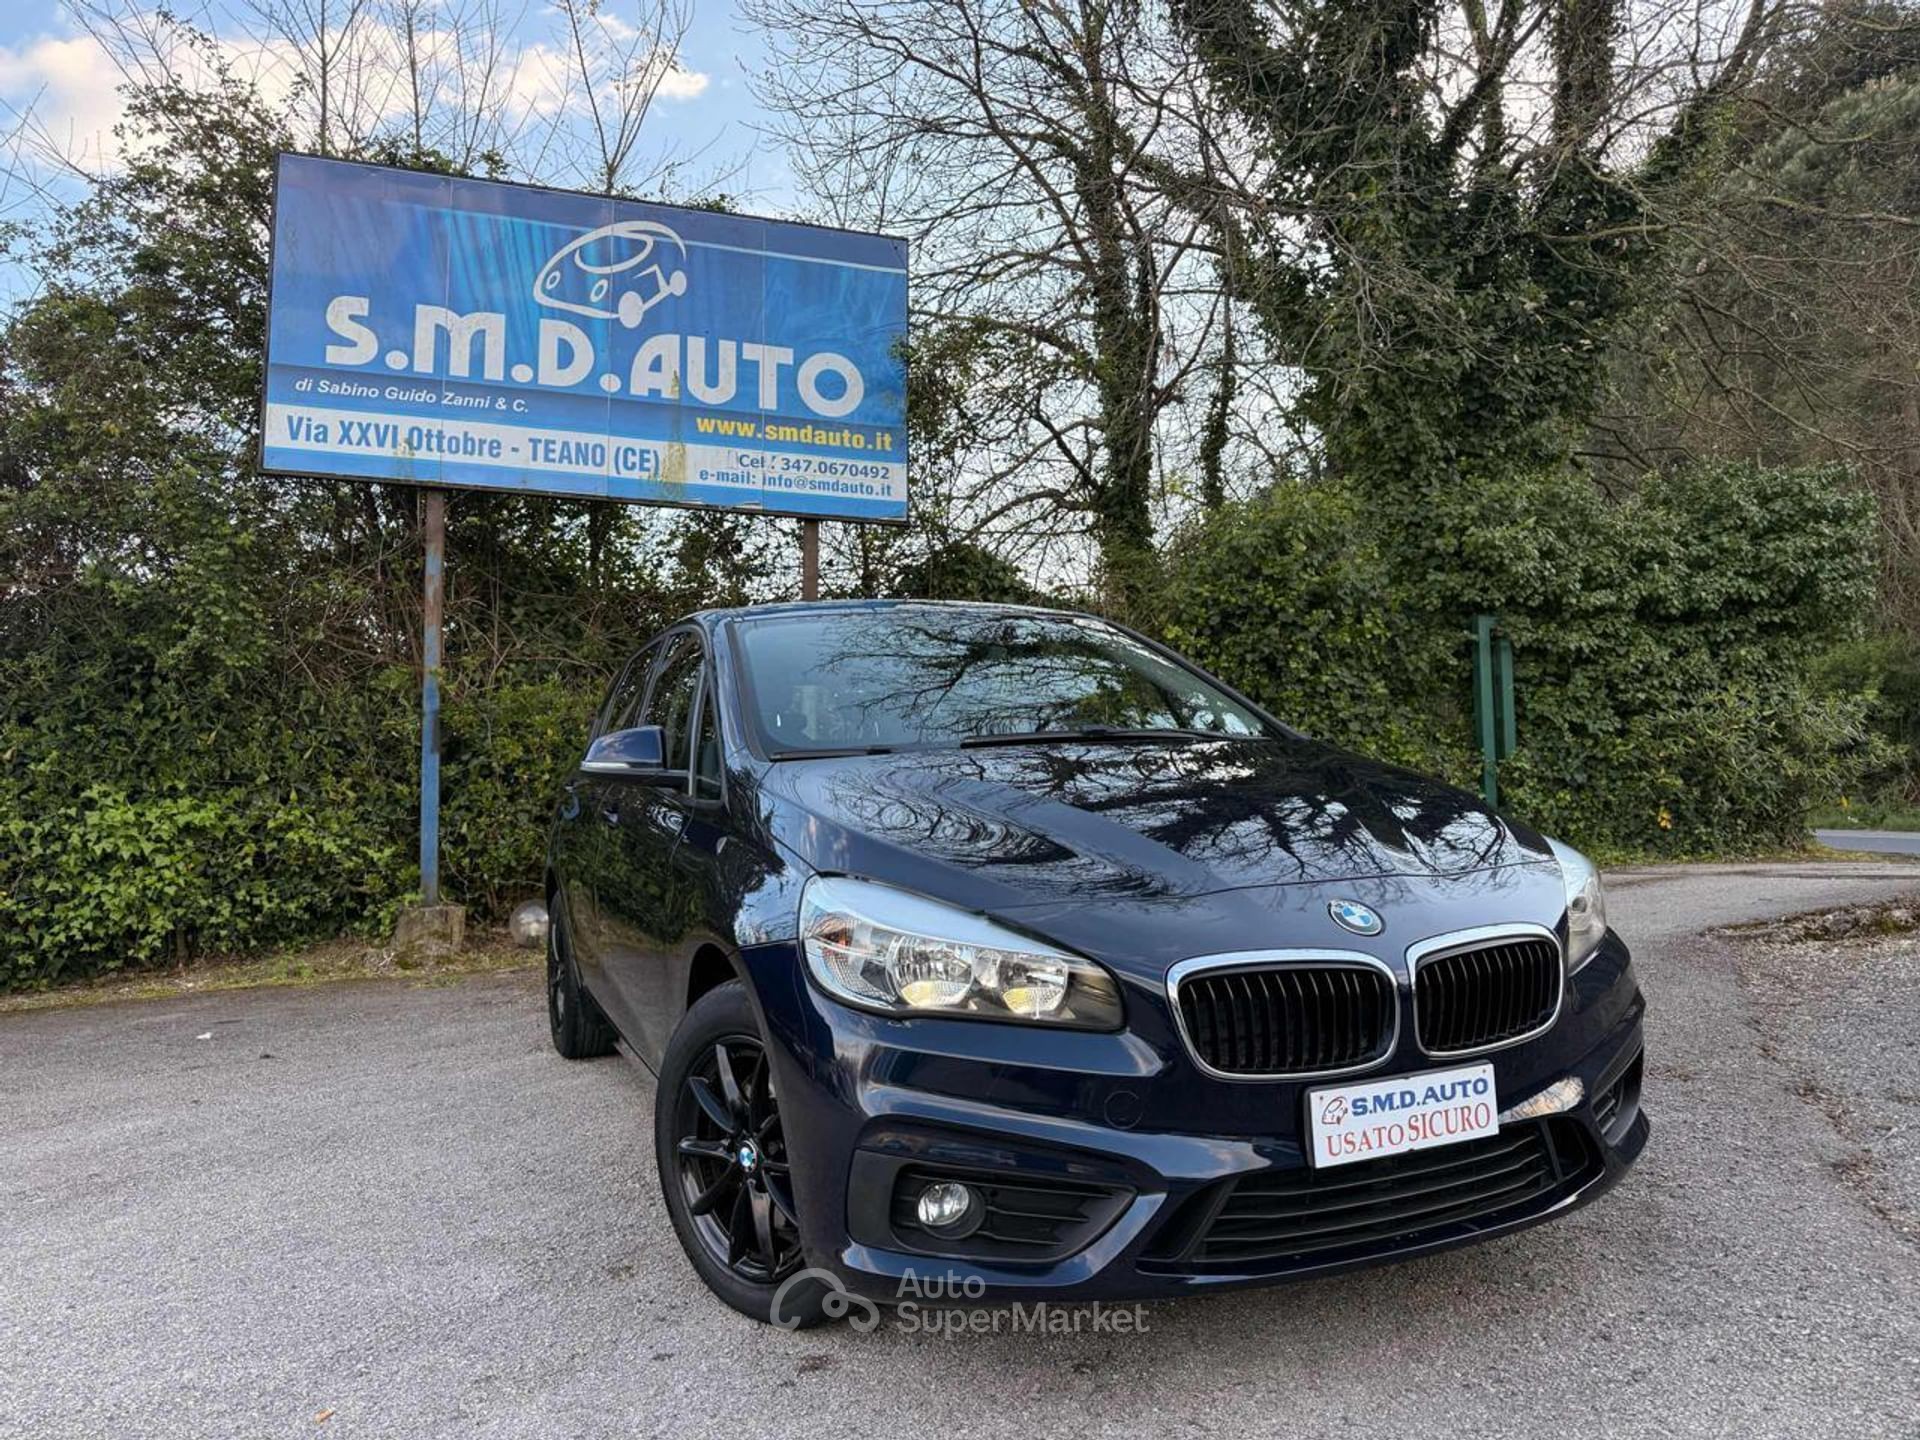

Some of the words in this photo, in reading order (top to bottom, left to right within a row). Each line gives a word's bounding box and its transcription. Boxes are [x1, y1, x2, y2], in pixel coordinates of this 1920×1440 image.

[295, 377, 313, 392] di
[317, 379, 380, 399] Sabino
[385, 386, 438, 404] Guido
[442, 392, 492, 410] Zanni
[495, 397, 508, 411] &
[512, 399, 529, 414] C.
[286, 414, 329, 445] Via
[337, 419, 399, 450] XXVI
[406, 425, 502, 459] Ottobre
[528, 437, 606, 468] TEANO
[614, 445, 660, 479] (CE)
[696, 416, 893, 451] www.smdauto.it
[699, 467, 757, 486] e-mail:
[762, 471, 893, 497] info@smdauto.it
[781, 456, 890, 480] 347.0670492
[1326, 1123, 1405, 1157] USATO
[1407, 1101, 1491, 1143] SICURO
